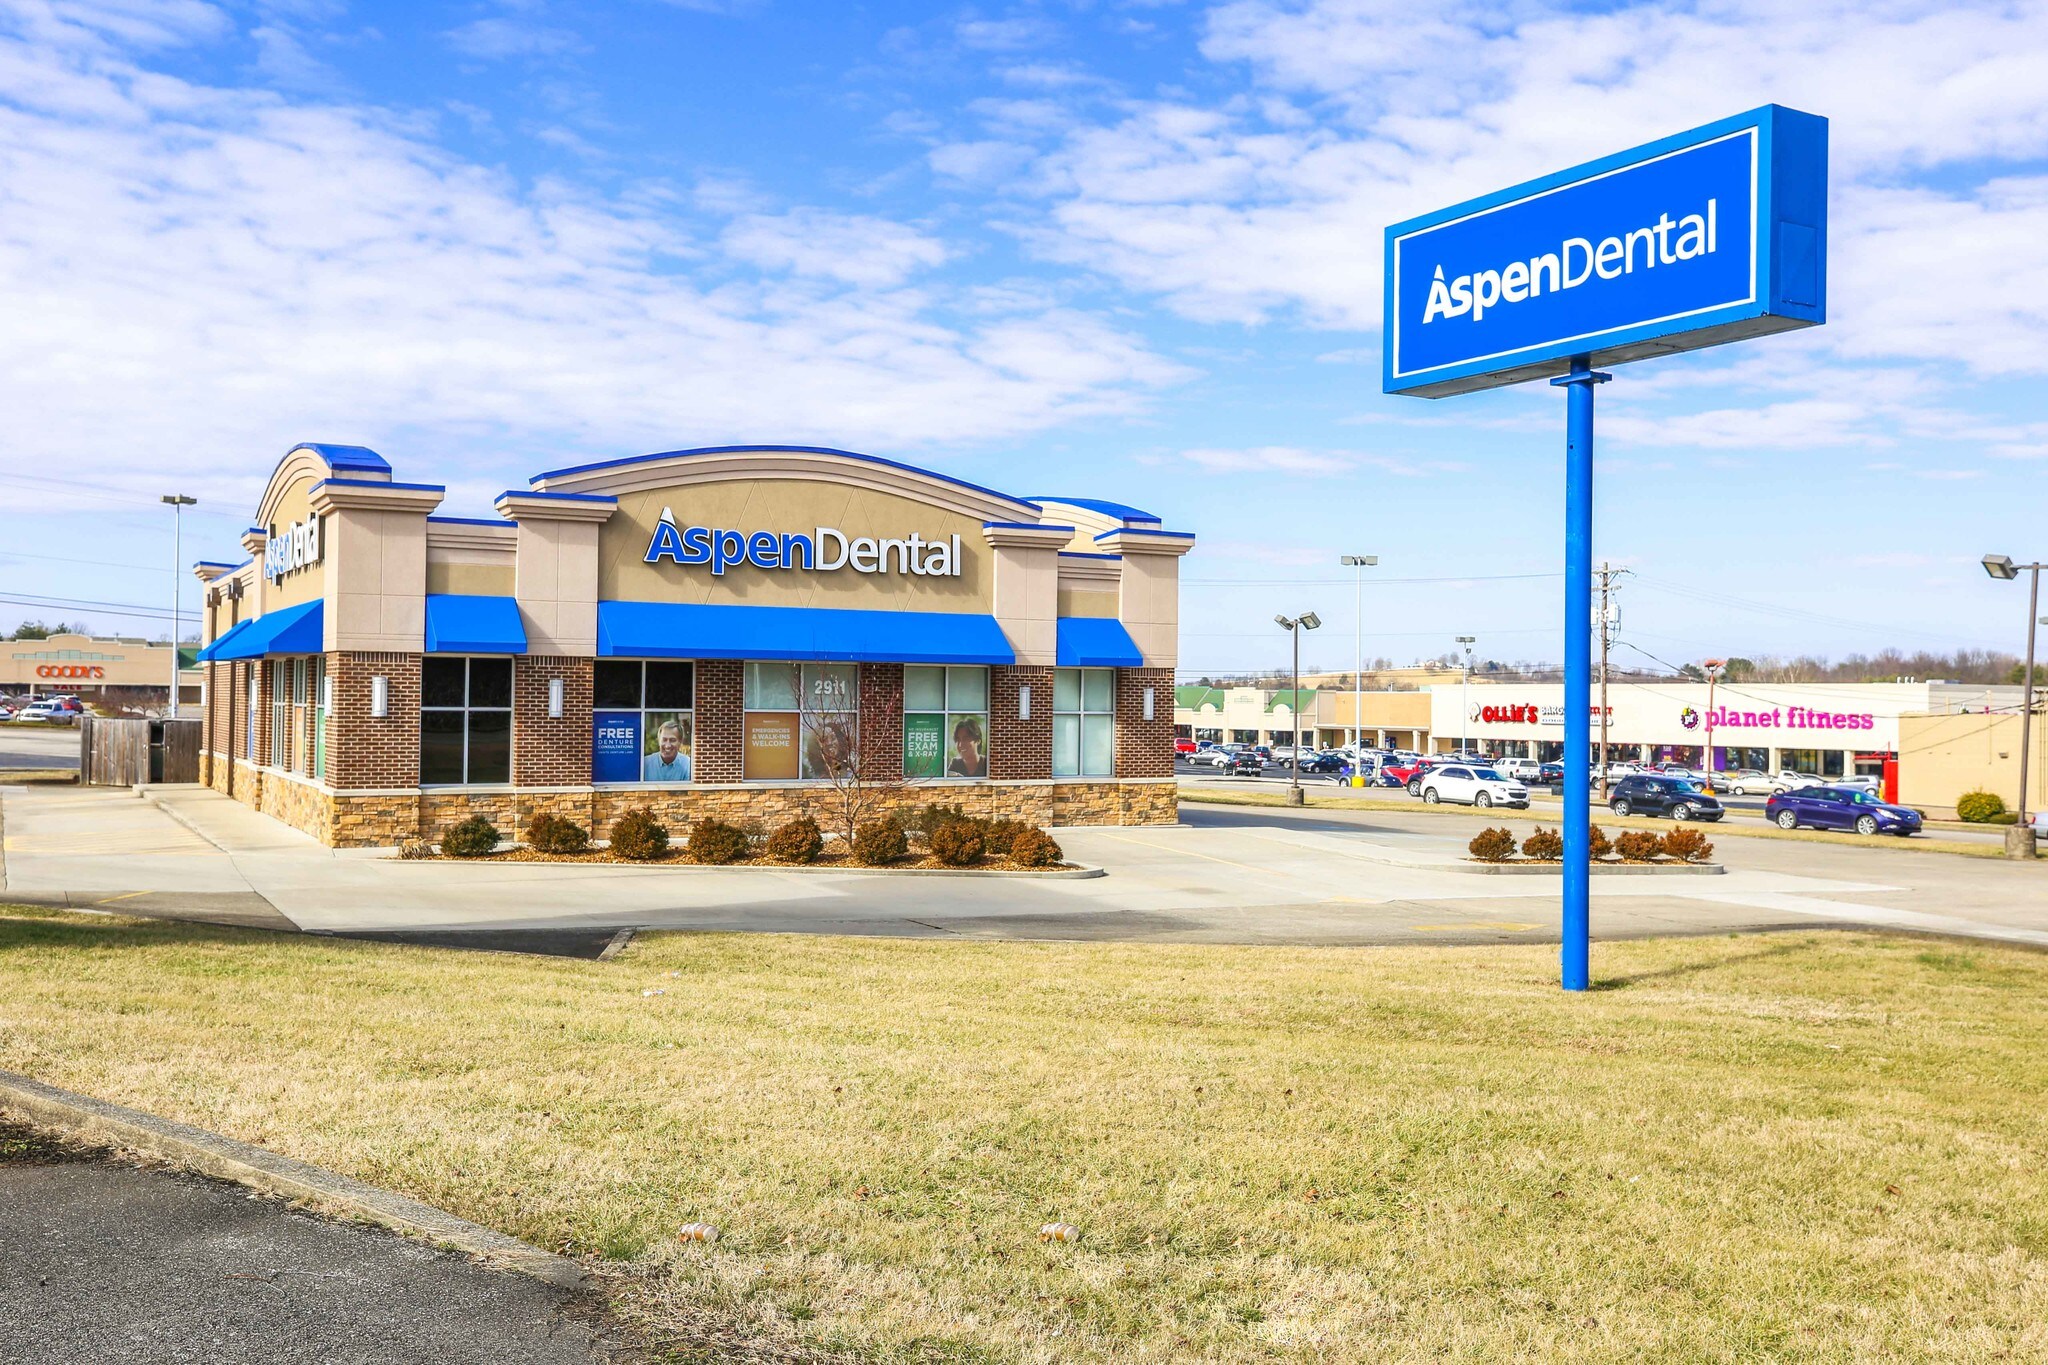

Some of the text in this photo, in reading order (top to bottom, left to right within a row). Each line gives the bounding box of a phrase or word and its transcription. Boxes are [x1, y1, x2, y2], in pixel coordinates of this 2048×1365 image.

[1422, 198, 1717, 325] AspenDental
[264, 510, 320, 587] AspenDental
[644, 506, 961, 577] AspenDental
[36, 664, 104, 679] GOODY'S
[814, 680, 846, 695] 2911
[1705, 706, 1875, 732] planet fitness
[598, 728, 634, 739] FREE
[908, 732, 938, 741] FREE
[908, 742, 938, 750] EXAM
